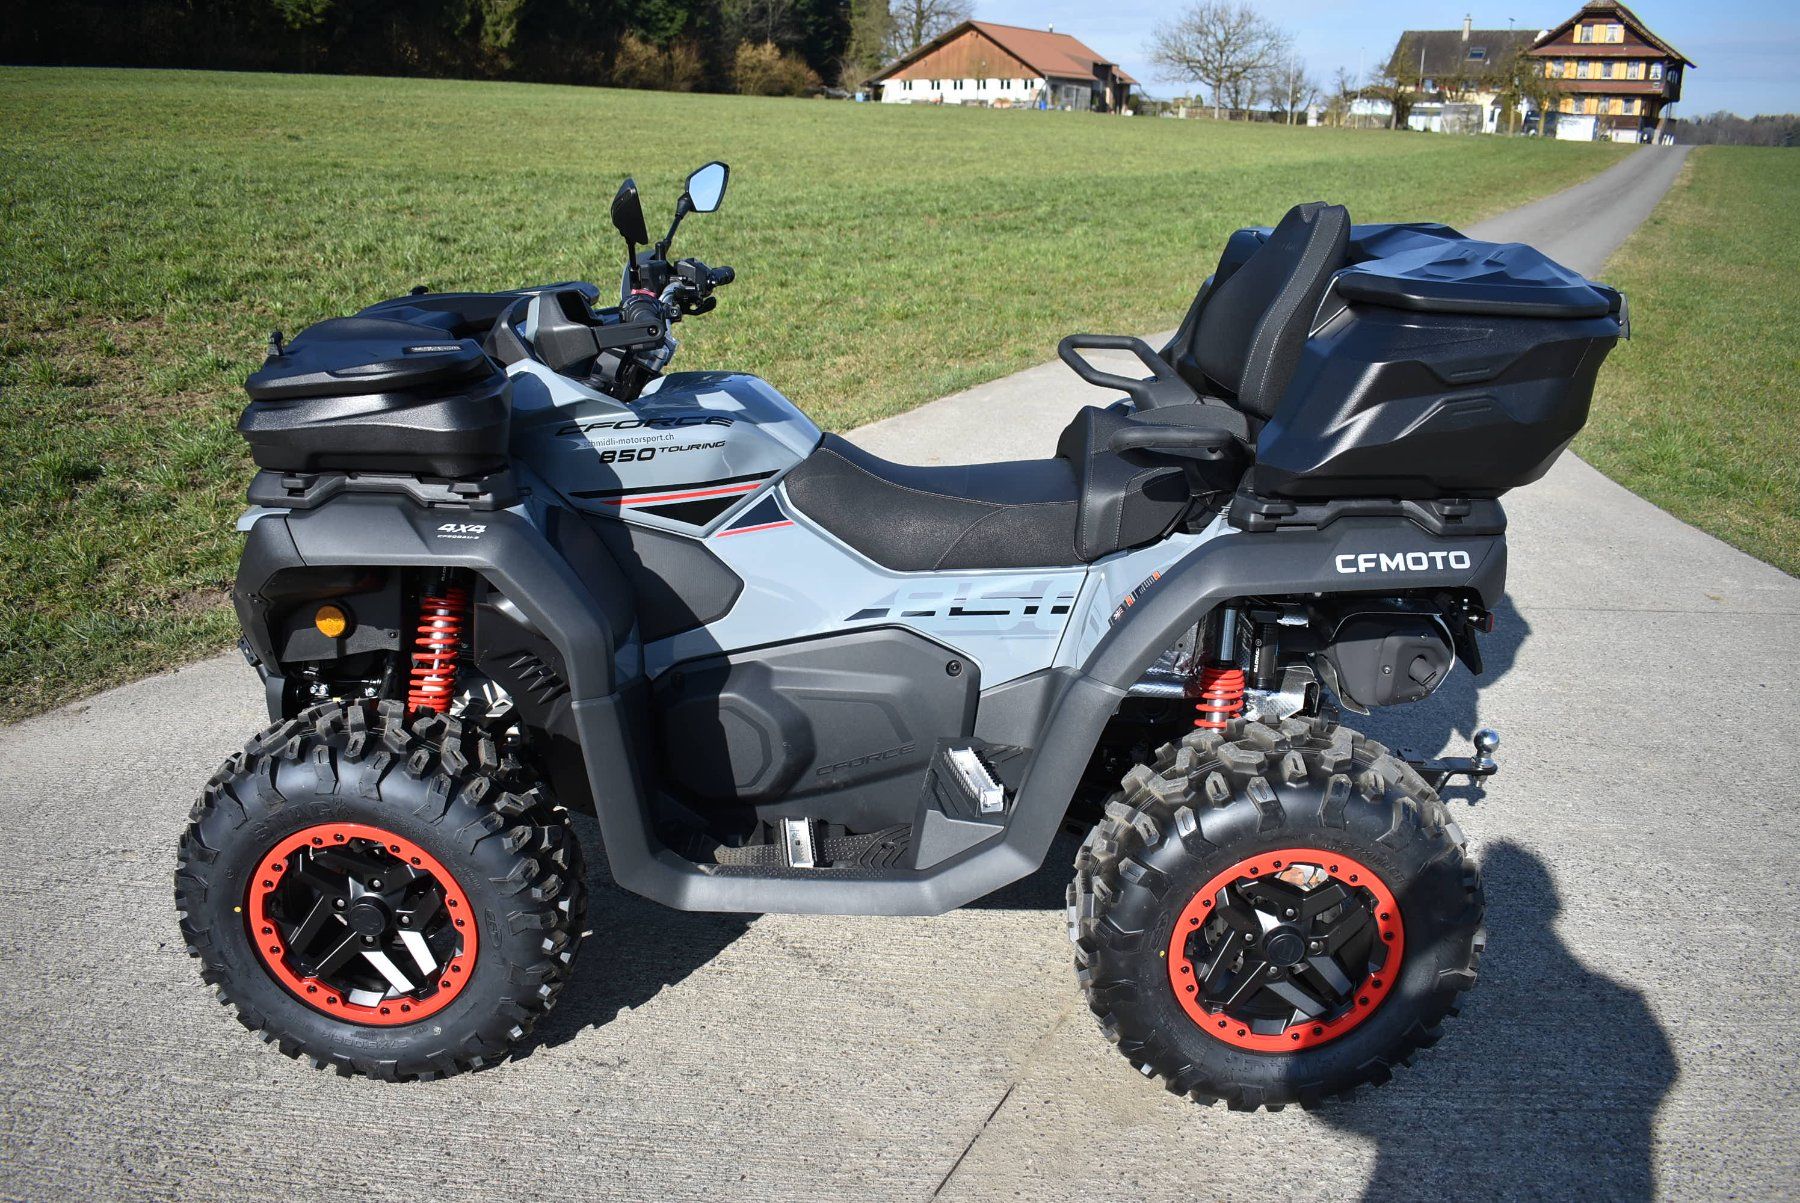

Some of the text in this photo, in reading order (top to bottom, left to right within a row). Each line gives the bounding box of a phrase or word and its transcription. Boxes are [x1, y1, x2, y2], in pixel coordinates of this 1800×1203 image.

[555, 415, 735, 437] CFORCE
[584, 432, 675, 448] schmidli-motorsport.ch
[600, 440, 726, 464] 850 TOURING
[1335, 550, 1471, 574] CFMOTO
[816, 743, 916, 775] CFORCE
